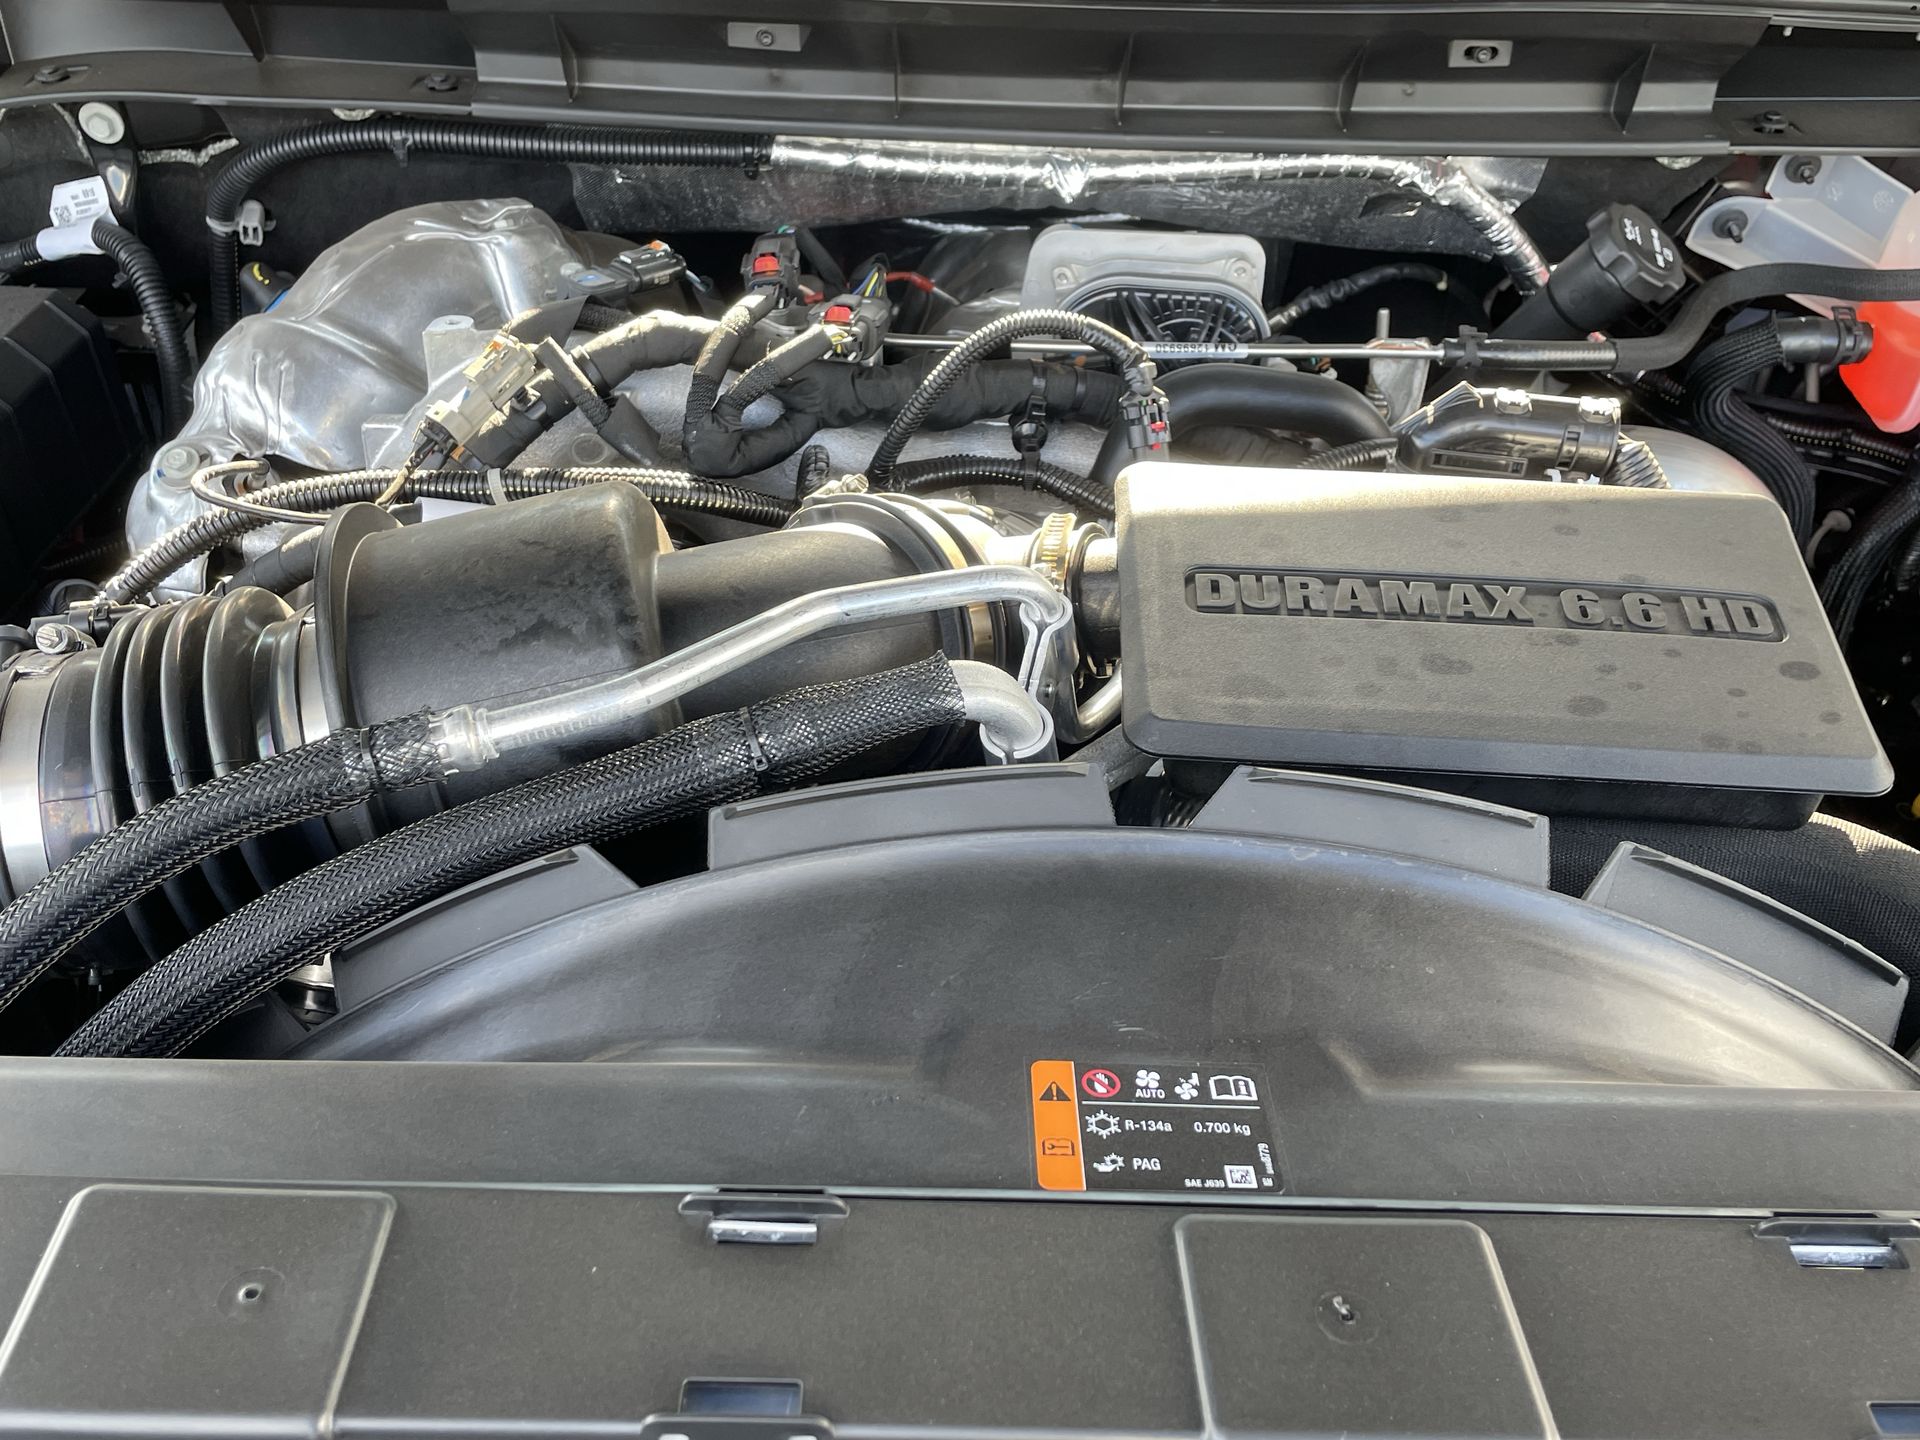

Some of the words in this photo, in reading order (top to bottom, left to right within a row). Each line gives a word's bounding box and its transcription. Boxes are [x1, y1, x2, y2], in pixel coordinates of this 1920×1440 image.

[1194, 573, 1533, 621] DURAMAX
[1558, 588, 1668, 631] 6.6
[1680, 595, 1776, 637] HD
[1135, 1089, 1166, 1099] AUTO
[1125, 1119, 1173, 1132] R-134a
[1194, 1121, 1231, 1134] 0.700
[1234, 1122, 1251, 1136] kg
[1133, 1157, 1162, 1171] PAG
[1184, 1178, 1202, 1188] SAE
